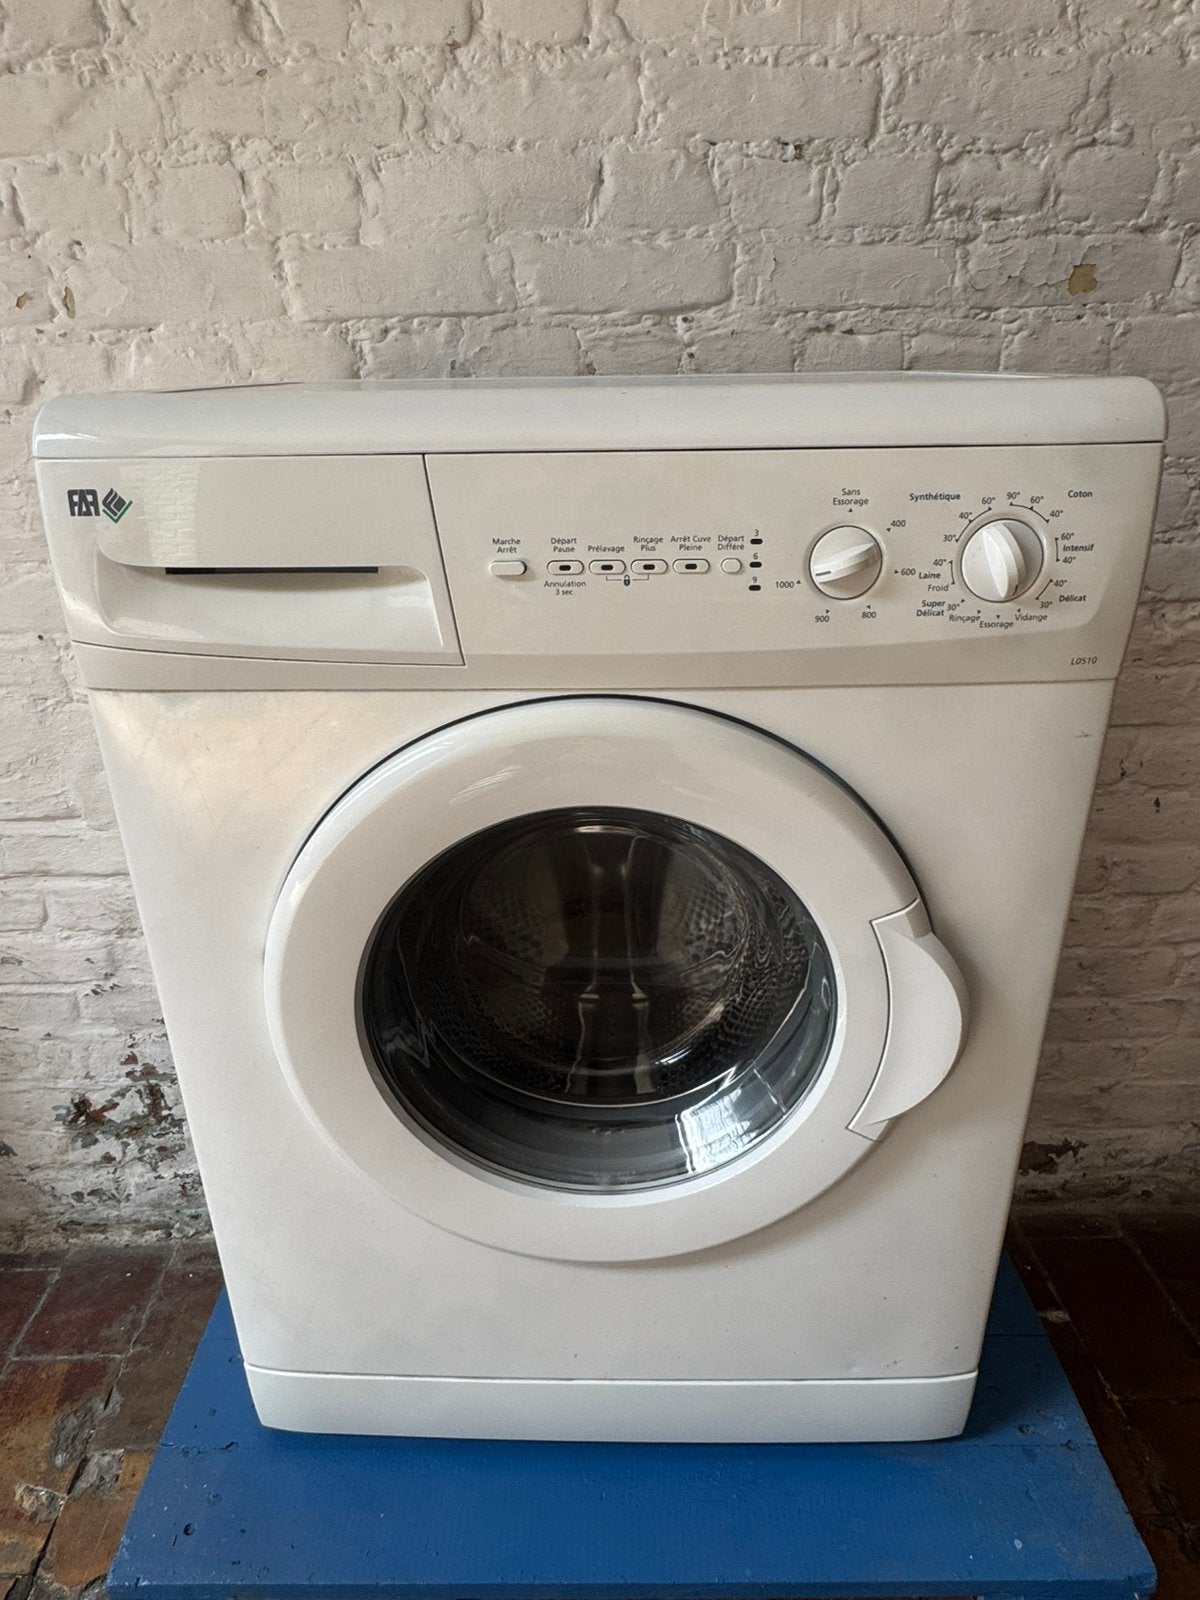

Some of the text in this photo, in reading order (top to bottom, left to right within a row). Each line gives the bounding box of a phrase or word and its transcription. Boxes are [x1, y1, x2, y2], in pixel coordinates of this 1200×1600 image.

[909, 493, 961, 502] Synthétique
[1067, 490, 1093, 498] Coton
[832, 498, 869, 506] Essorage
[981, 497, 996, 505] 60°
[1030, 496, 1044, 504] 60°
[1050, 510, 1063, 518] 40°
[633, 536, 664, 544] Rinçage
[670, 535, 712, 543] Arrêt Cuve
[717, 534, 744, 544] Départ
[943, 534, 956, 542] 30°
[550, 538, 577, 547] Départ
[588, 545, 625, 553] Prélavage
[718, 543, 744, 551] Différé
[1062, 544, 1094, 552] Intensif
[932, 558, 947, 566] 40°
[1062, 556, 1076, 564] 40°
[900, 568, 916, 576] 600
[1058, 594, 1086, 602] Délicat
[922, 600, 946, 608] Super
[916, 609, 944, 617] Délicat
[949, 614, 981, 623] Rinçage
[1014, 614, 1048, 622] Vidange
[979, 620, 1014, 630] Essorage
